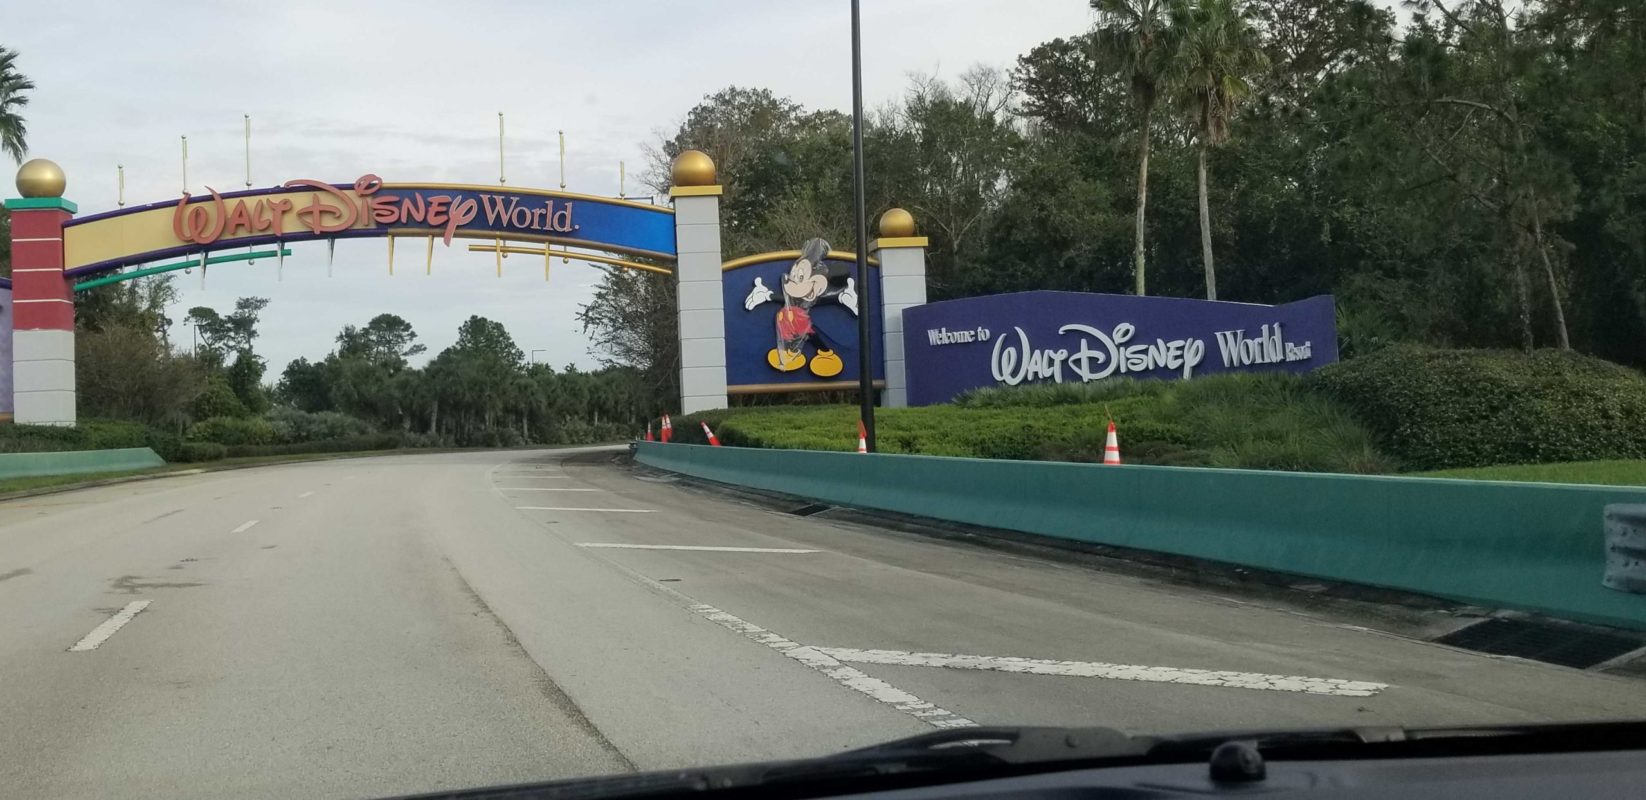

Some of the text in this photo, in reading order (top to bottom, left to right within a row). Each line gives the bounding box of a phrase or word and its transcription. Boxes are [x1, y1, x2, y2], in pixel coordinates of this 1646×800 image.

[927, 327, 976, 346] Welcome
[977, 326, 991, 342] to
[1214, 322, 1285, 367] World
